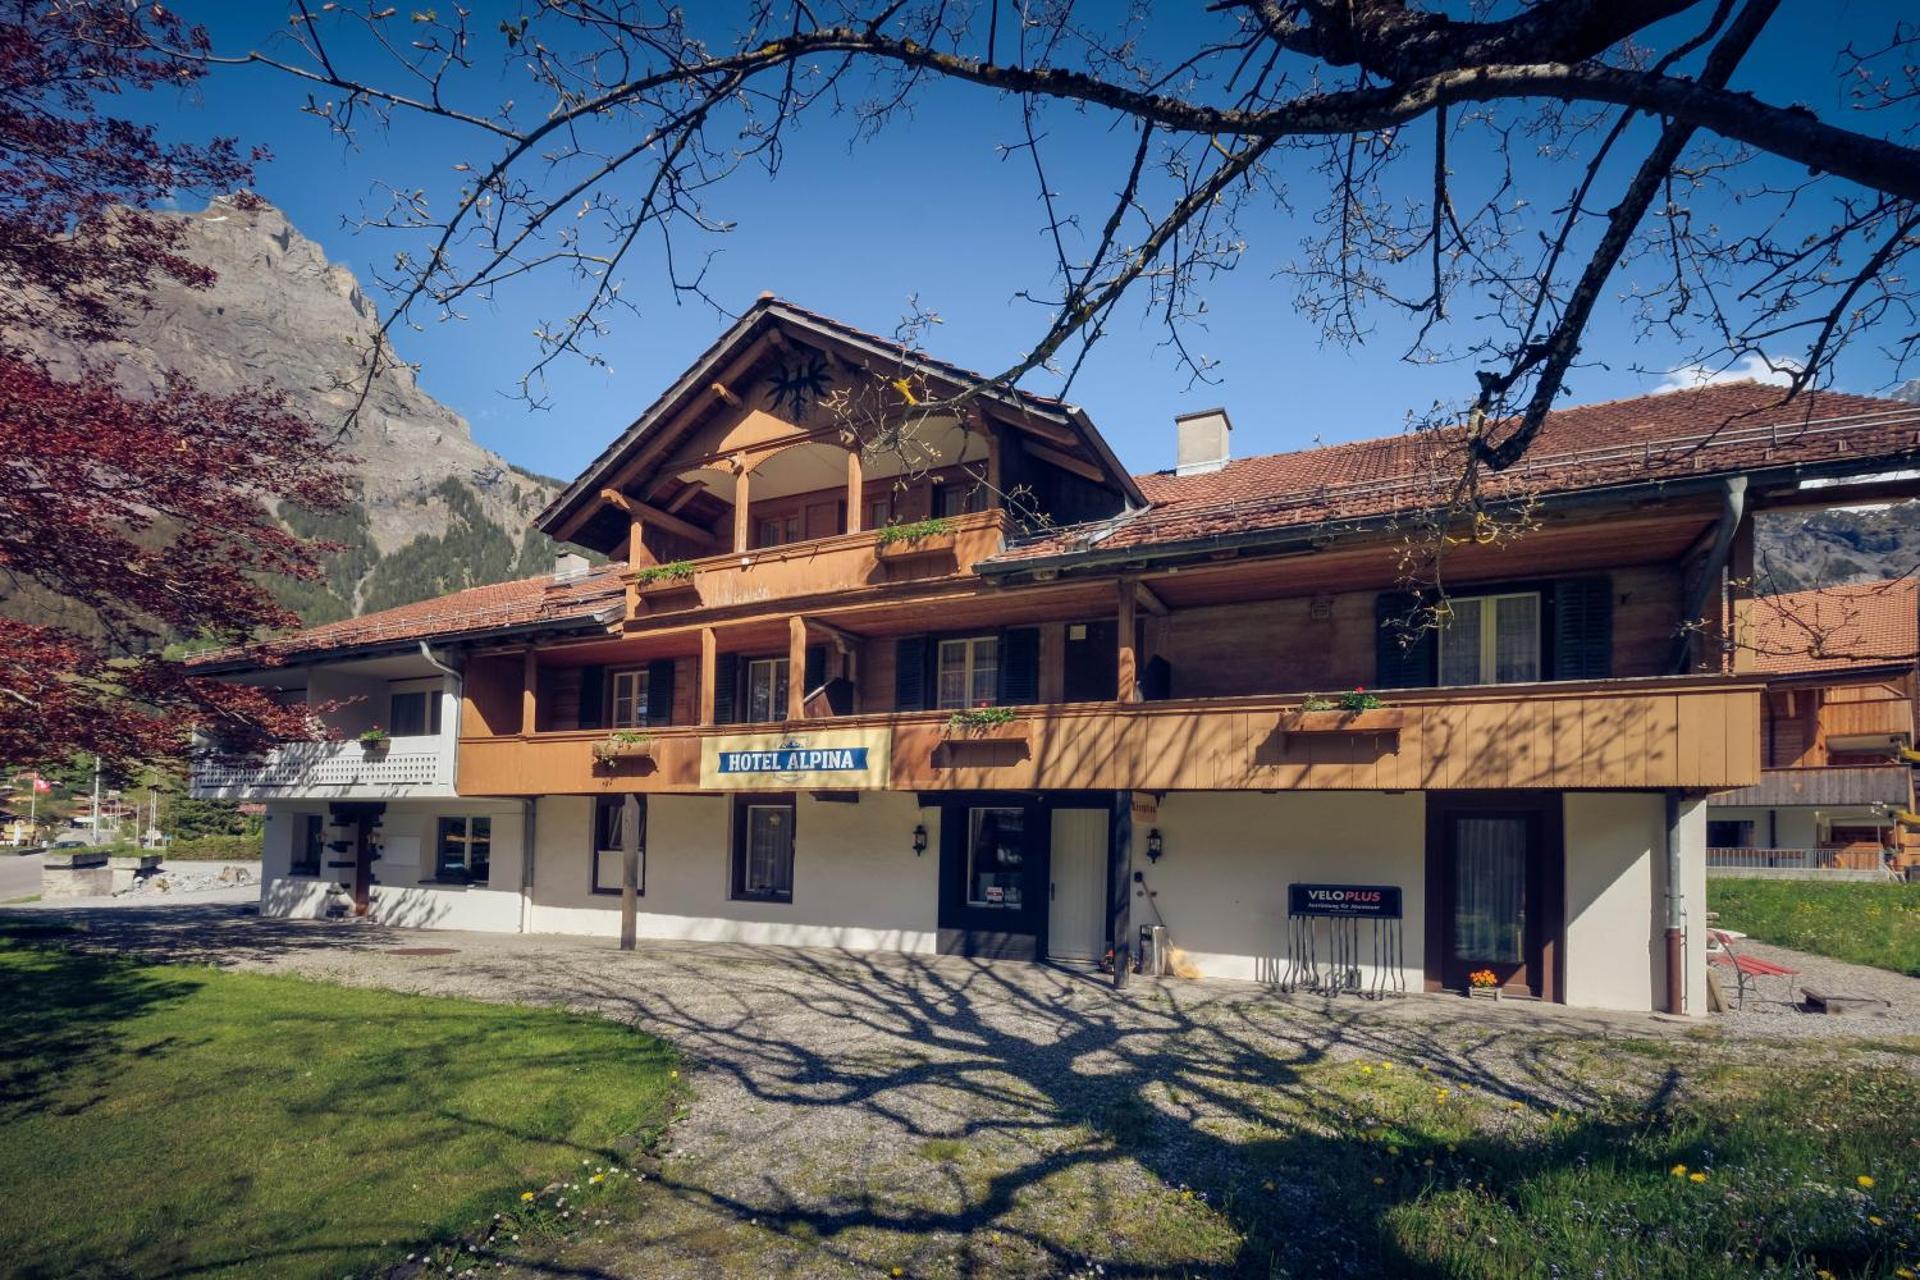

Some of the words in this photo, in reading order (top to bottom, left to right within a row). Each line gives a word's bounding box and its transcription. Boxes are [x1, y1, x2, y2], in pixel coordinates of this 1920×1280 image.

[728, 753, 781, 771] HOTEL
[786, 750, 854, 770] ALPINA
[1308, 890, 1381, 902] VELOPLUS
